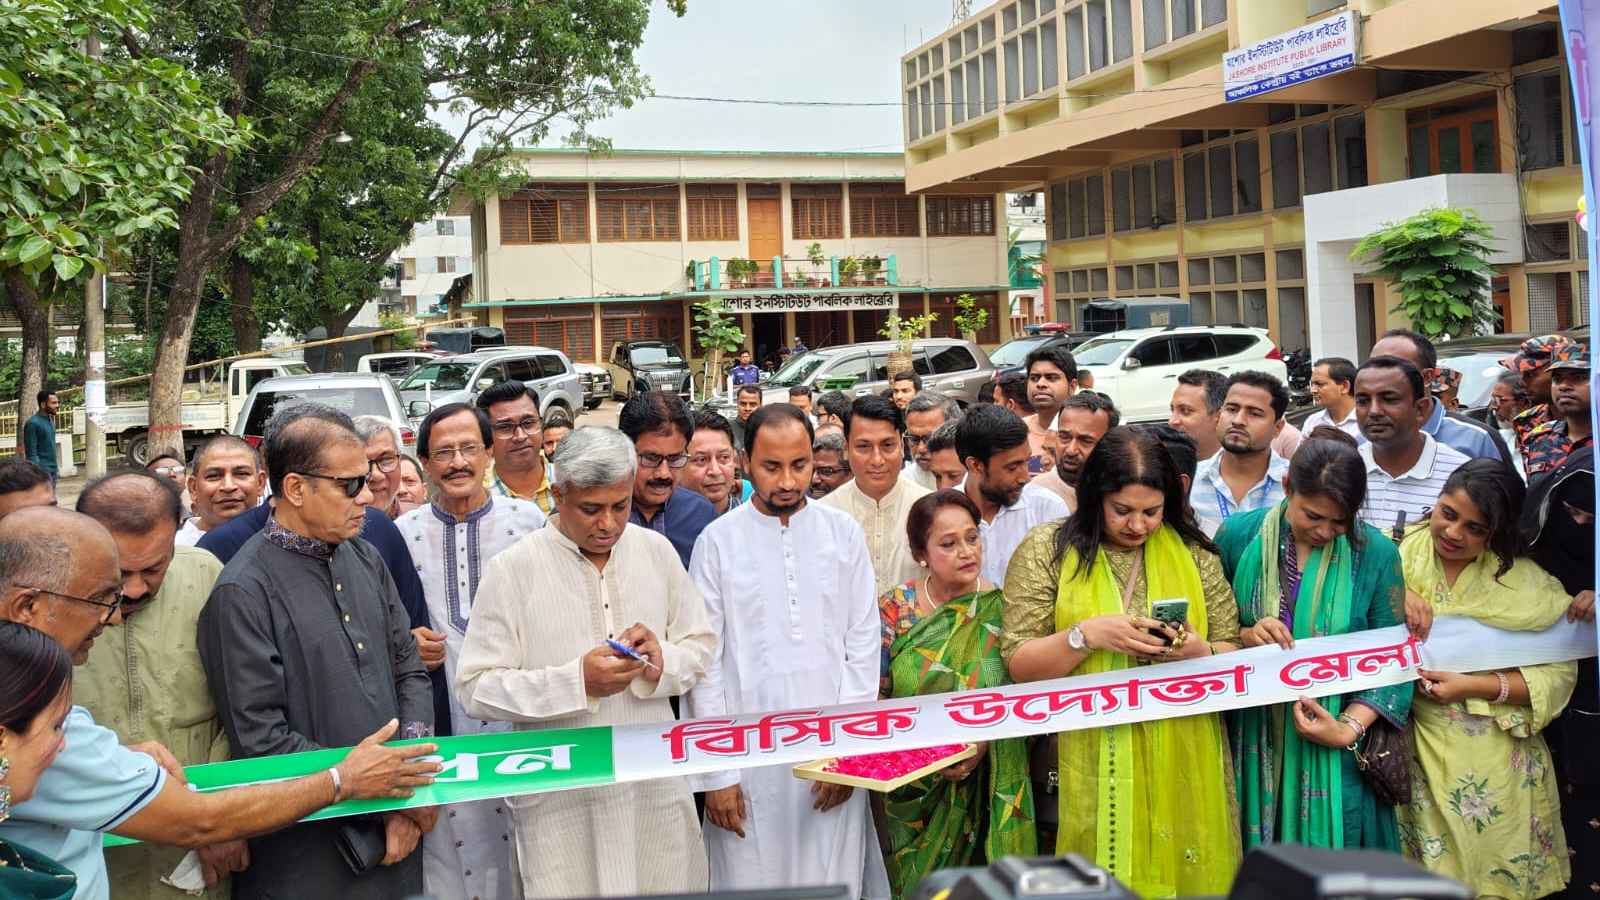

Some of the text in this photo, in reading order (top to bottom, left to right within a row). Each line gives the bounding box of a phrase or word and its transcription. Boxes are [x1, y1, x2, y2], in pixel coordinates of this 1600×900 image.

[1257, 54, 1289, 71] INSTITUTE
[1290, 46, 1315, 61] PUBLIC
[1316, 37, 1347, 54] LIBRARY
[754, 293, 811, 310] ইনস্টিটিউট
[813, 292, 852, 307] পাবলিক
[854, 291, 894, 306] লাইব্রেরি
[662, 635, 1424, 763] বিসিক উদ্যোক্তা মেলা
